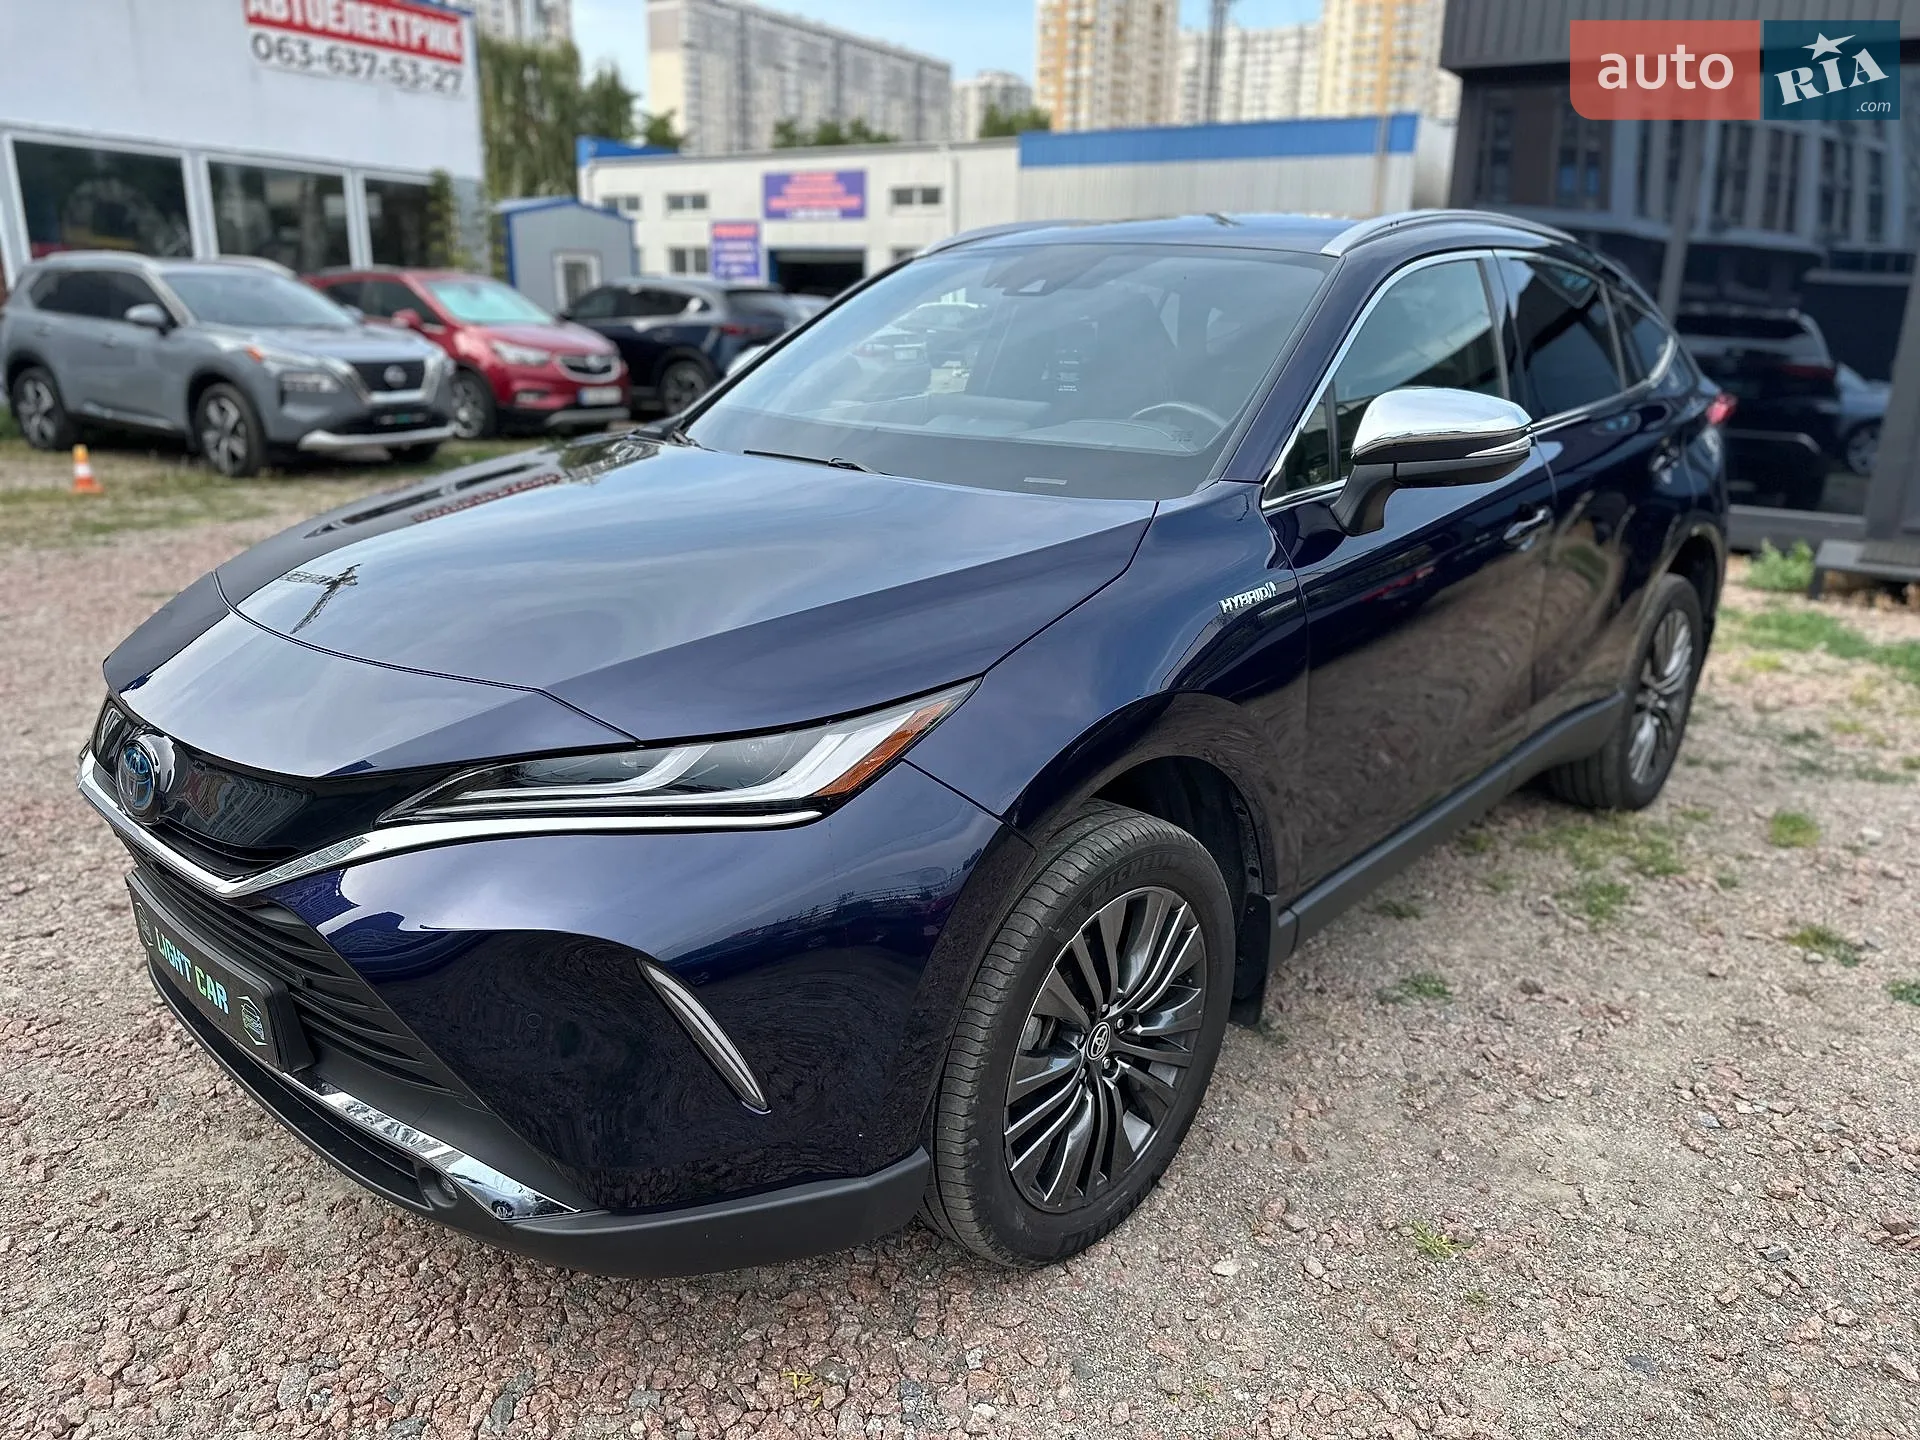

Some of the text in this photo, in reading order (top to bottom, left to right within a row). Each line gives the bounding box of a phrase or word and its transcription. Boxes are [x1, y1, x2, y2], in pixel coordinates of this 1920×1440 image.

[251, 32, 464, 93] 063-637-53-27
[1219, 585, 1269, 614] HYBRID
[155, 926, 230, 1014] LIGHT CAR
